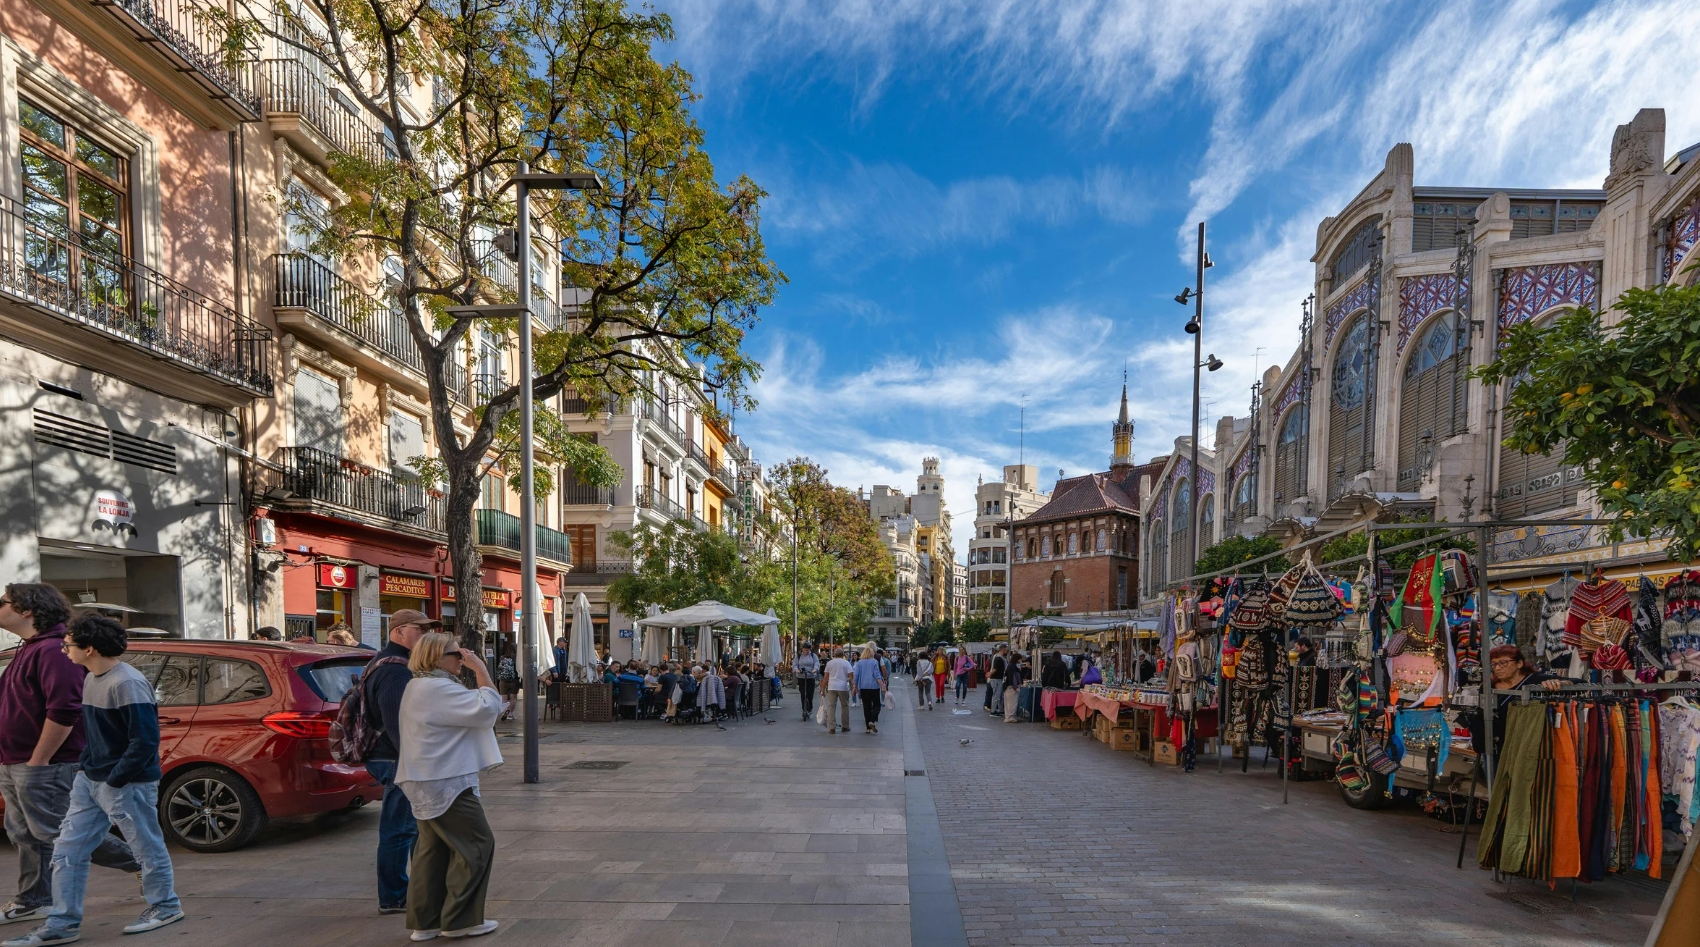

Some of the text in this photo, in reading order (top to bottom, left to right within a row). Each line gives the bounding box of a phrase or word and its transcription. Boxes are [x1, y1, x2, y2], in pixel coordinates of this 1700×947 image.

[98, 498, 129, 508] SOUVENIRS
[109, 508, 130, 517] LONJA
[386, 576, 426, 586] CALAMARES
[386, 584, 426, 594] PESCADITOS
